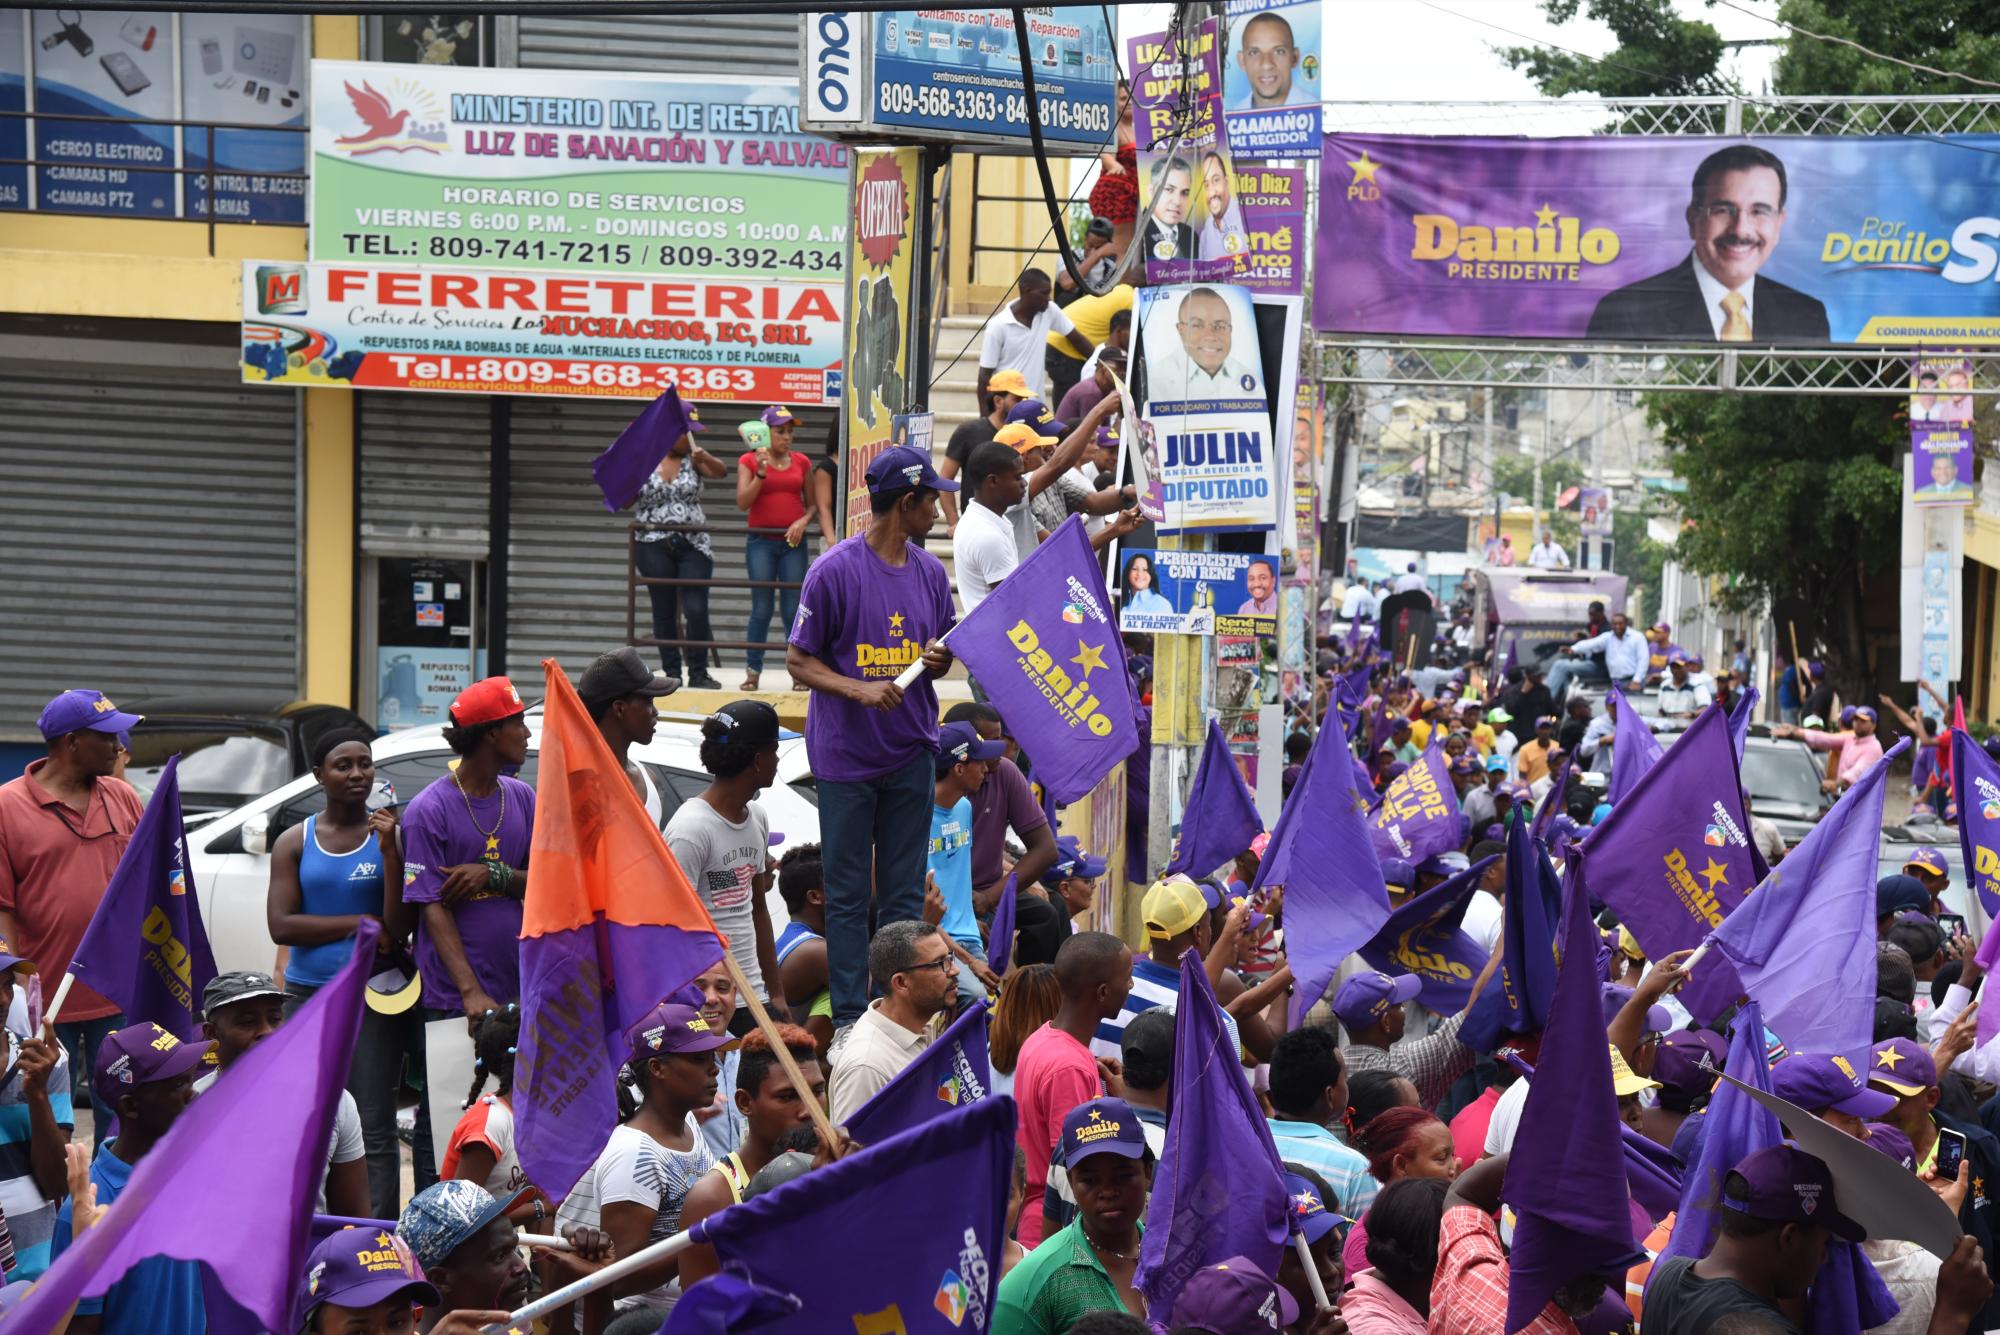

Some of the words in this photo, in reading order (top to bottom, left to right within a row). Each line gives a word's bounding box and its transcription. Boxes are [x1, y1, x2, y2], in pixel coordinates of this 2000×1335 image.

[969, 15, 985, 25] con
[1031, 20, 1080, 38] Reparación
[880, 81, 996, 122] 809-568-3363
[451, 93, 603, 129] MINISTERIO
[610, 100, 661, 131] INT.
[669, 102, 703, 132] DE
[464, 129, 515, 156] LUZ
[524, 133, 559, 157] DE
[567, 134, 705, 164] SANACIÓN
[715, 139, 734, 164] Y
[1230, 135, 1247, 148] MI
[1250, 130, 1308, 146] REGIDOR
[50, 141, 93, 158] CERCO
[95, 143, 164, 162] ELECTRICO
[50, 166, 106, 183] CAMARAS
[199, 175, 251, 193] CNTROL
[253, 177, 267, 193] DE
[1260, 173, 1292, 194] Diaz
[50, 189, 107, 207] CAMARAS
[108, 191, 135, 208] PTZ
[442, 187, 561, 208] HORARIO
[568, 191, 601, 210] DE
[609, 193, 746, 214] SERVICIOS
[1347, 185, 1382, 202] PLD
[198, 199, 251, 216] AARMAS
[861, 180, 903, 239] OFERTA
[355, 208, 463, 229] VIERNES
[469, 212, 520, 232] 6:00
[527, 214, 573, 234] P.M.
[595, 216, 729, 240] DOMINGOS
[736, 221, 801, 242] 10:00
[1861, 216, 1907, 238] Por
[342, 233, 418, 256] TEL.:
[429, 236, 631, 264] 809-741-7215
[1225, 233, 1238, 252] 3
[1411, 212, 1622, 265] Danilo
[1820, 232, 1950, 263] Danilo
[1940, 216, 2000, 283] S
[1448, 262, 1581, 281] PRESIDENTE
[327, 269, 842, 323] FERRETERIA
[348, 306, 403, 327] Centro
[408, 311, 428, 327] de
[433, 308, 505, 331] Servicios
[762, 323, 813, 346] SRL
[1876, 327, 1968, 338] COORDINADORA
[438, 338, 463, 352] PARA
[465, 340, 513, 354] BOMBAS
[515, 342, 531, 354] DE
[532, 343, 564, 356] AGUA
[644, 348, 713, 361] ELECTRICOS
[717, 350, 725, 361] Y
[728, 350, 742, 362] DE
[745, 351, 801, 364] PLOMERIA
[812, 382, 822, 391] DE
[1212, 403, 1218, 411] Y
[1219, 401, 1264, 411] TRABAJADOR
[1163, 431, 1263, 468] JULIN
[1164, 468, 1200, 477] ANGEL
[1204, 466, 1251, 475] HEREDIA
[1163, 477, 1269, 503] DIPUTADO
[1154, 551, 1250, 568] PERREDEISTAS
[1169, 566, 1199, 580] CON
[1200, 567, 1236, 581] RENE
[1066, 575, 1108, 624] DECISIÓN
[1067, 588, 1099, 620] Nacional
[889, 629, 904, 637] PLD
[1126, 621, 1139, 630] AL
[1141, 622, 1179, 630] FRENTE
[420, 663, 472, 672] REPUESTOS
[1006, 619, 1112, 736] Danilo
[427, 685, 463, 693] BOMBAS
[434, 675, 457, 683] PARA
[1016, 656, 1080, 728] PRESIDENTE
[722, 850, 738, 866] OLD
[739, 846, 760, 860] NAVY
[1664, 848, 1725, 929] Danilo
[1664, 872, 1705, 923] PRESIDENTE
[1075, 1119, 1121, 1141] Danilo
[1081, 1131, 1119, 1144] PRESIDENTE
